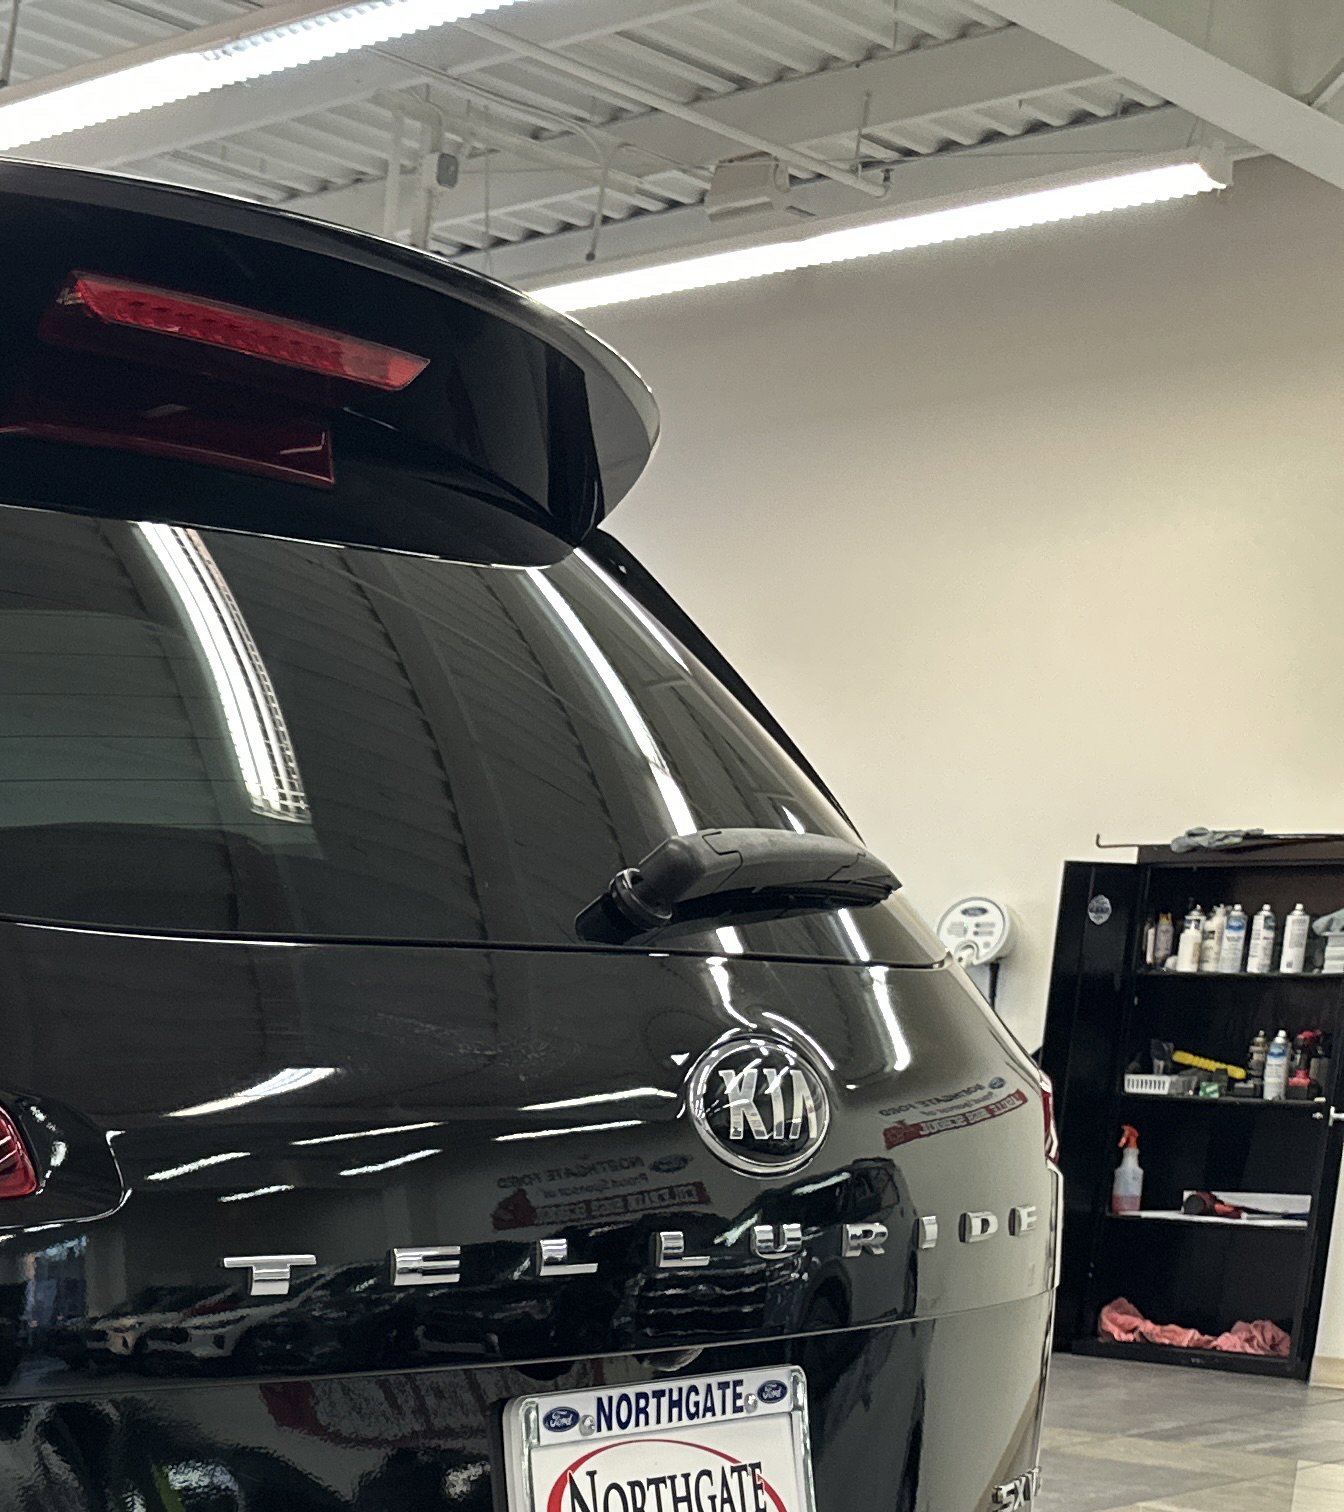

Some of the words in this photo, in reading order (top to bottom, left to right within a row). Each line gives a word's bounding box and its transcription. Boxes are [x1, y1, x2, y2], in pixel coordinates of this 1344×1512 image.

[718, 1068, 817, 1140] KIA
[220, 1205, 1038, 1296] TELLURIDE
[547, 1408, 576, 1431] Ford
[596, 1379, 744, 1433] NORTHGATE
